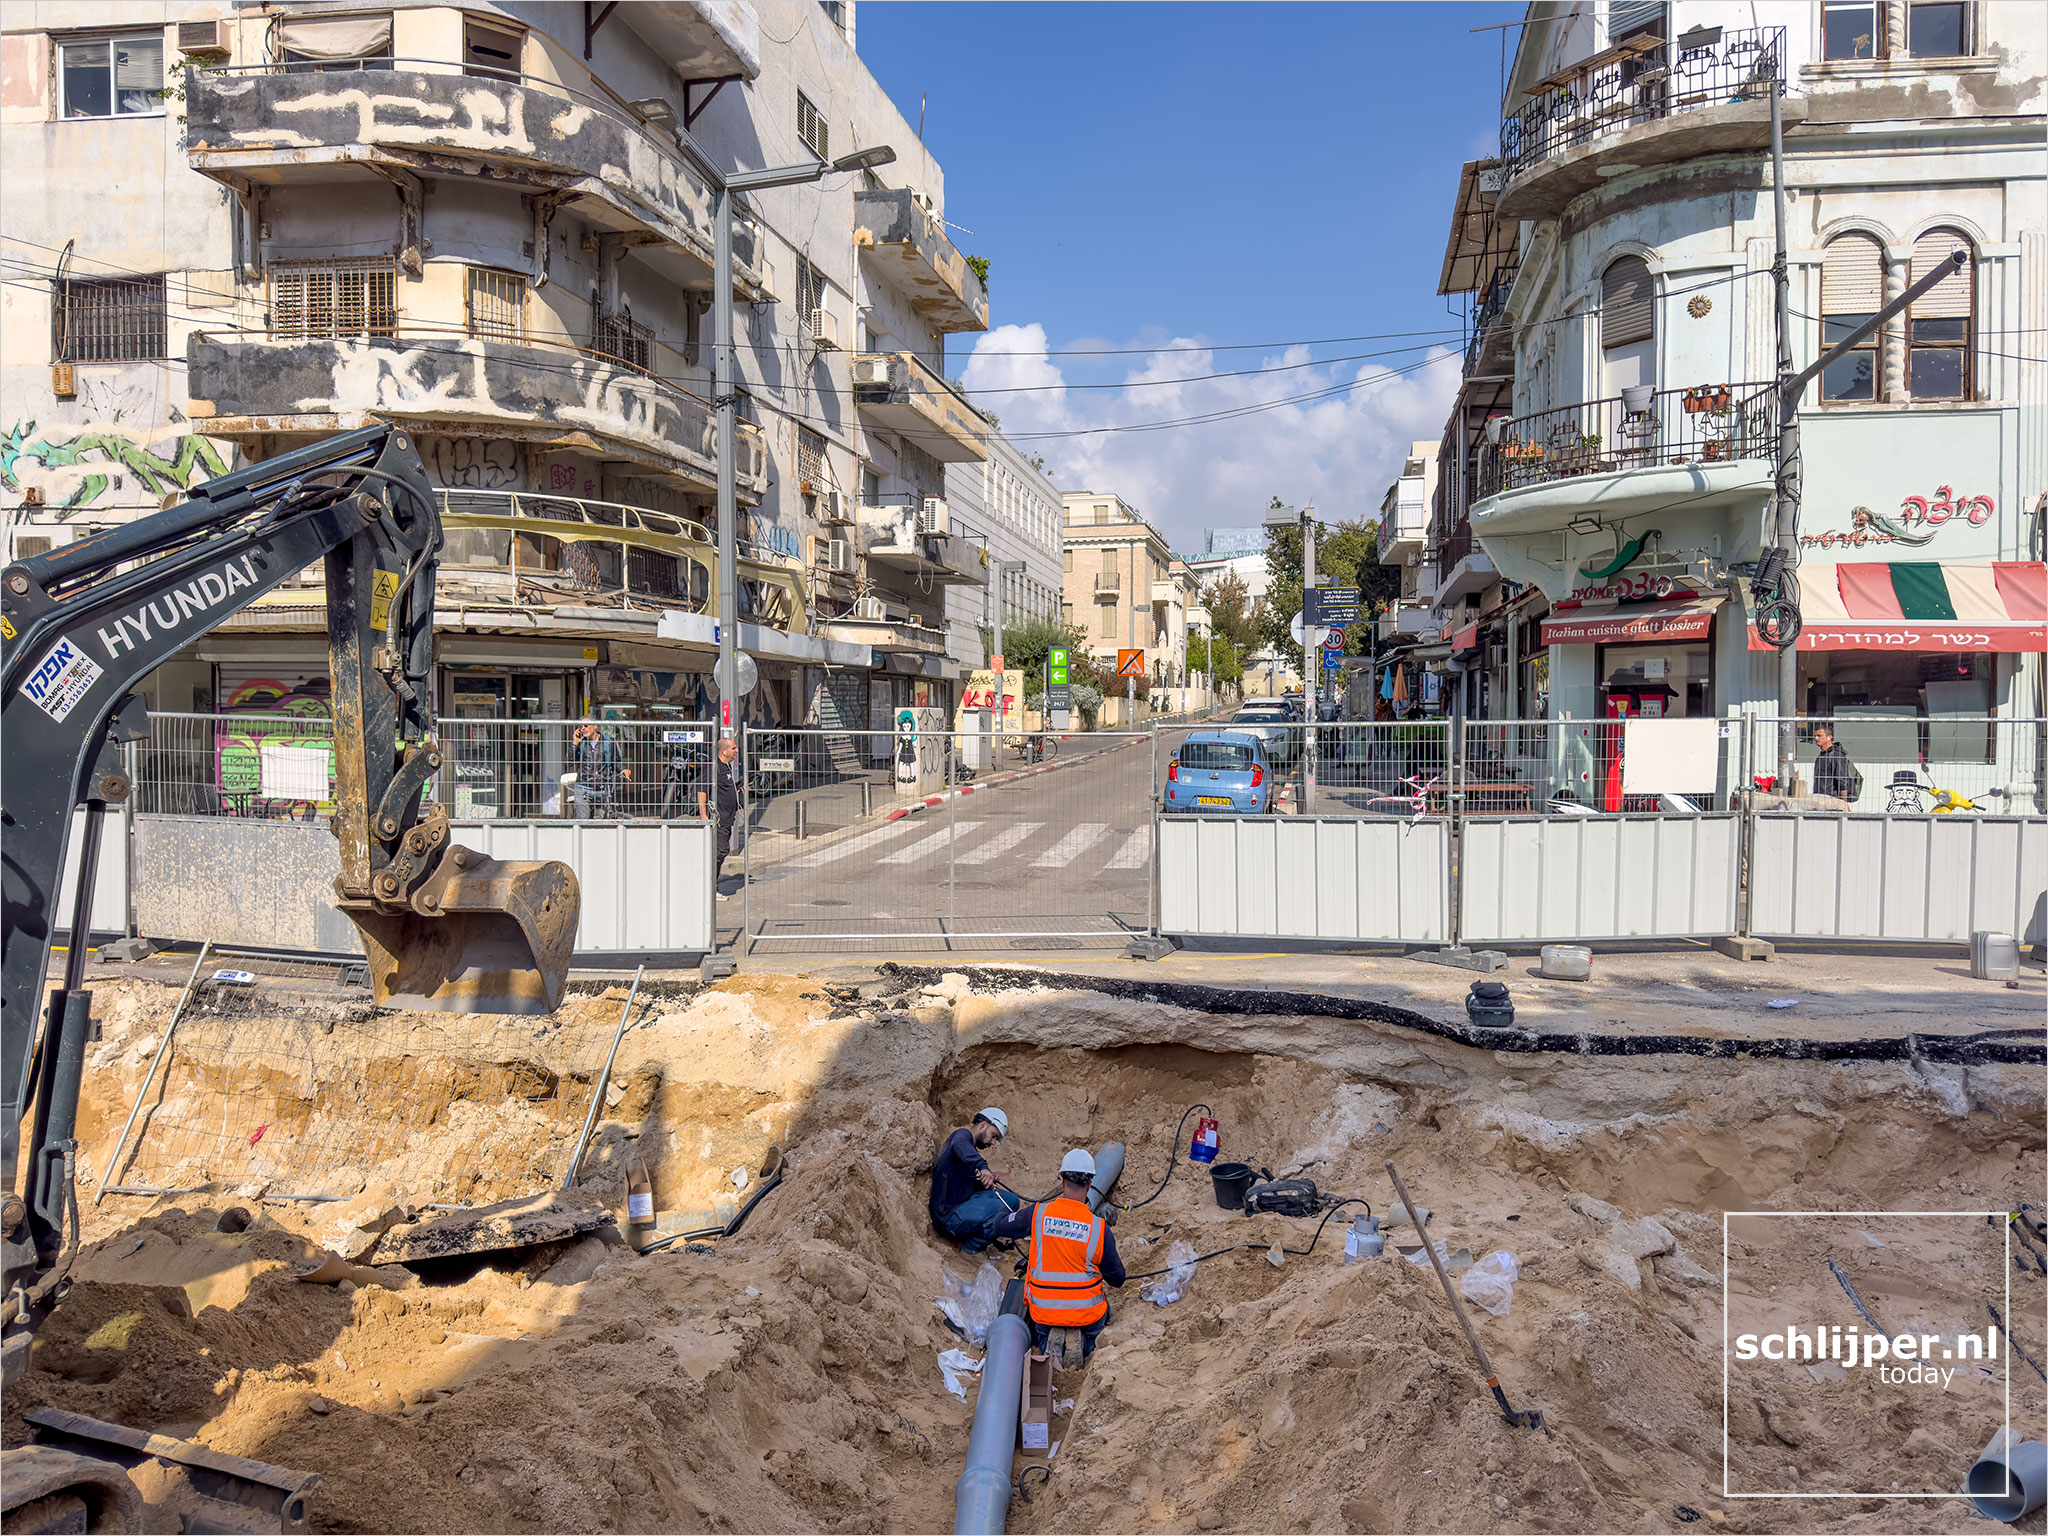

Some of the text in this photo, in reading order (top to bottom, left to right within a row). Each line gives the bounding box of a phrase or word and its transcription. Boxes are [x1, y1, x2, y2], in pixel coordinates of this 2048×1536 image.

[1901, 485, 1995, 526] פיצה
[1616, 572, 1673, 599] פיצה
[97, 555, 259, 659] HYUNDAI
[1327, 634, 1341, 644] 30
[1547, 619, 1705, 639] Italian cuisine glatt kosher
[1807, 630, 1991, 648] כשר למהדרין
[25, 641, 74, 699] אפקו
[1054, 651, 1064, 664] P
[41, 656, 87, 709] BOMAG TEREX
[49, 662, 94, 715] MST HYUNDAI
[60, 674, 94, 713] 03-5563652
[1045, 1217, 1052, 1226] דן
[1072, 1222, 1089, 1231] מרכז
